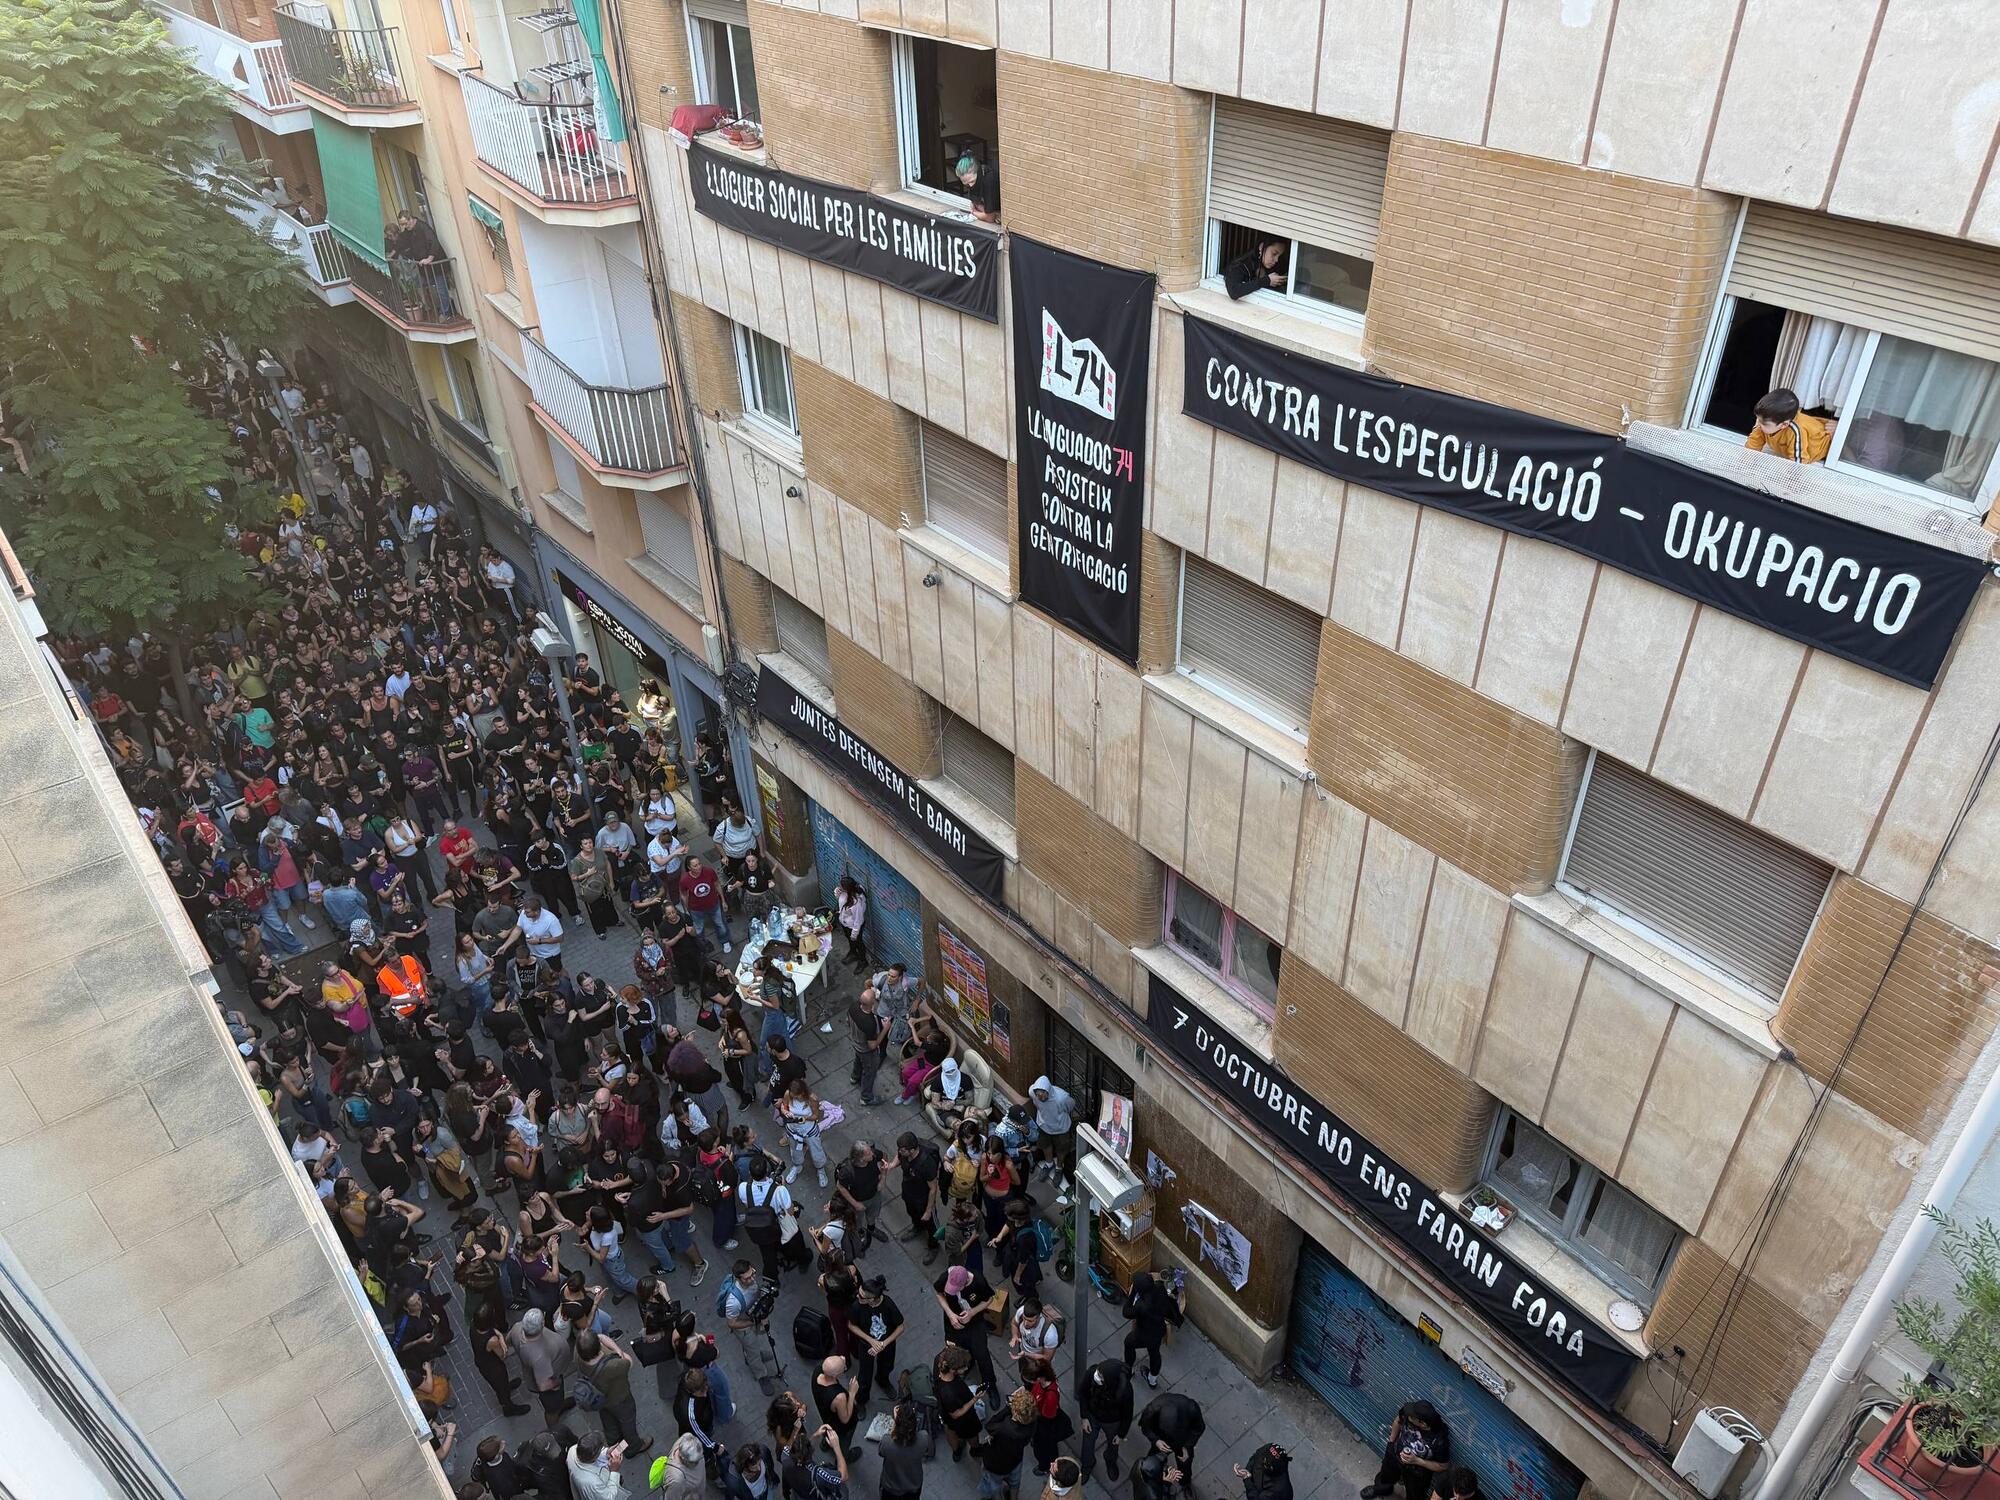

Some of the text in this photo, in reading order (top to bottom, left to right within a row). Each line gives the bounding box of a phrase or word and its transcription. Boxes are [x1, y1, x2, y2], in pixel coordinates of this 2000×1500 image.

[704, 160, 978, 279] LLOGUER SOCIAL PER LES FAMÍLIES
[1054, 330, 1107, 409] L74
[1041, 492, 1113, 553] CONTRA LA
[1205, 357, 1321, 442] CONTRA
[1333, 402, 1604, 523] L'ESPECULACIÓ
[1663, 501, 1922, 635] OKUPACIO
[1030, 522, 1128, 594] GENTRIFICACIÓ
[790, 695, 837, 743] JUNTES
[838, 729, 905, 799] DEFENSEM
[908, 785, 923, 820] EL
[926, 803, 966, 857] BARRI
[1172, 1006, 1190, 1030] 7
[1195, 1025, 1313, 1136] D'OCTUBRE
[1317, 1121, 1352, 1166] NO
[1359, 1153, 1412, 1211] ENS
[1417, 1198, 1503, 1287] FARAN
[1512, 1281, 1585, 1358] FORA
